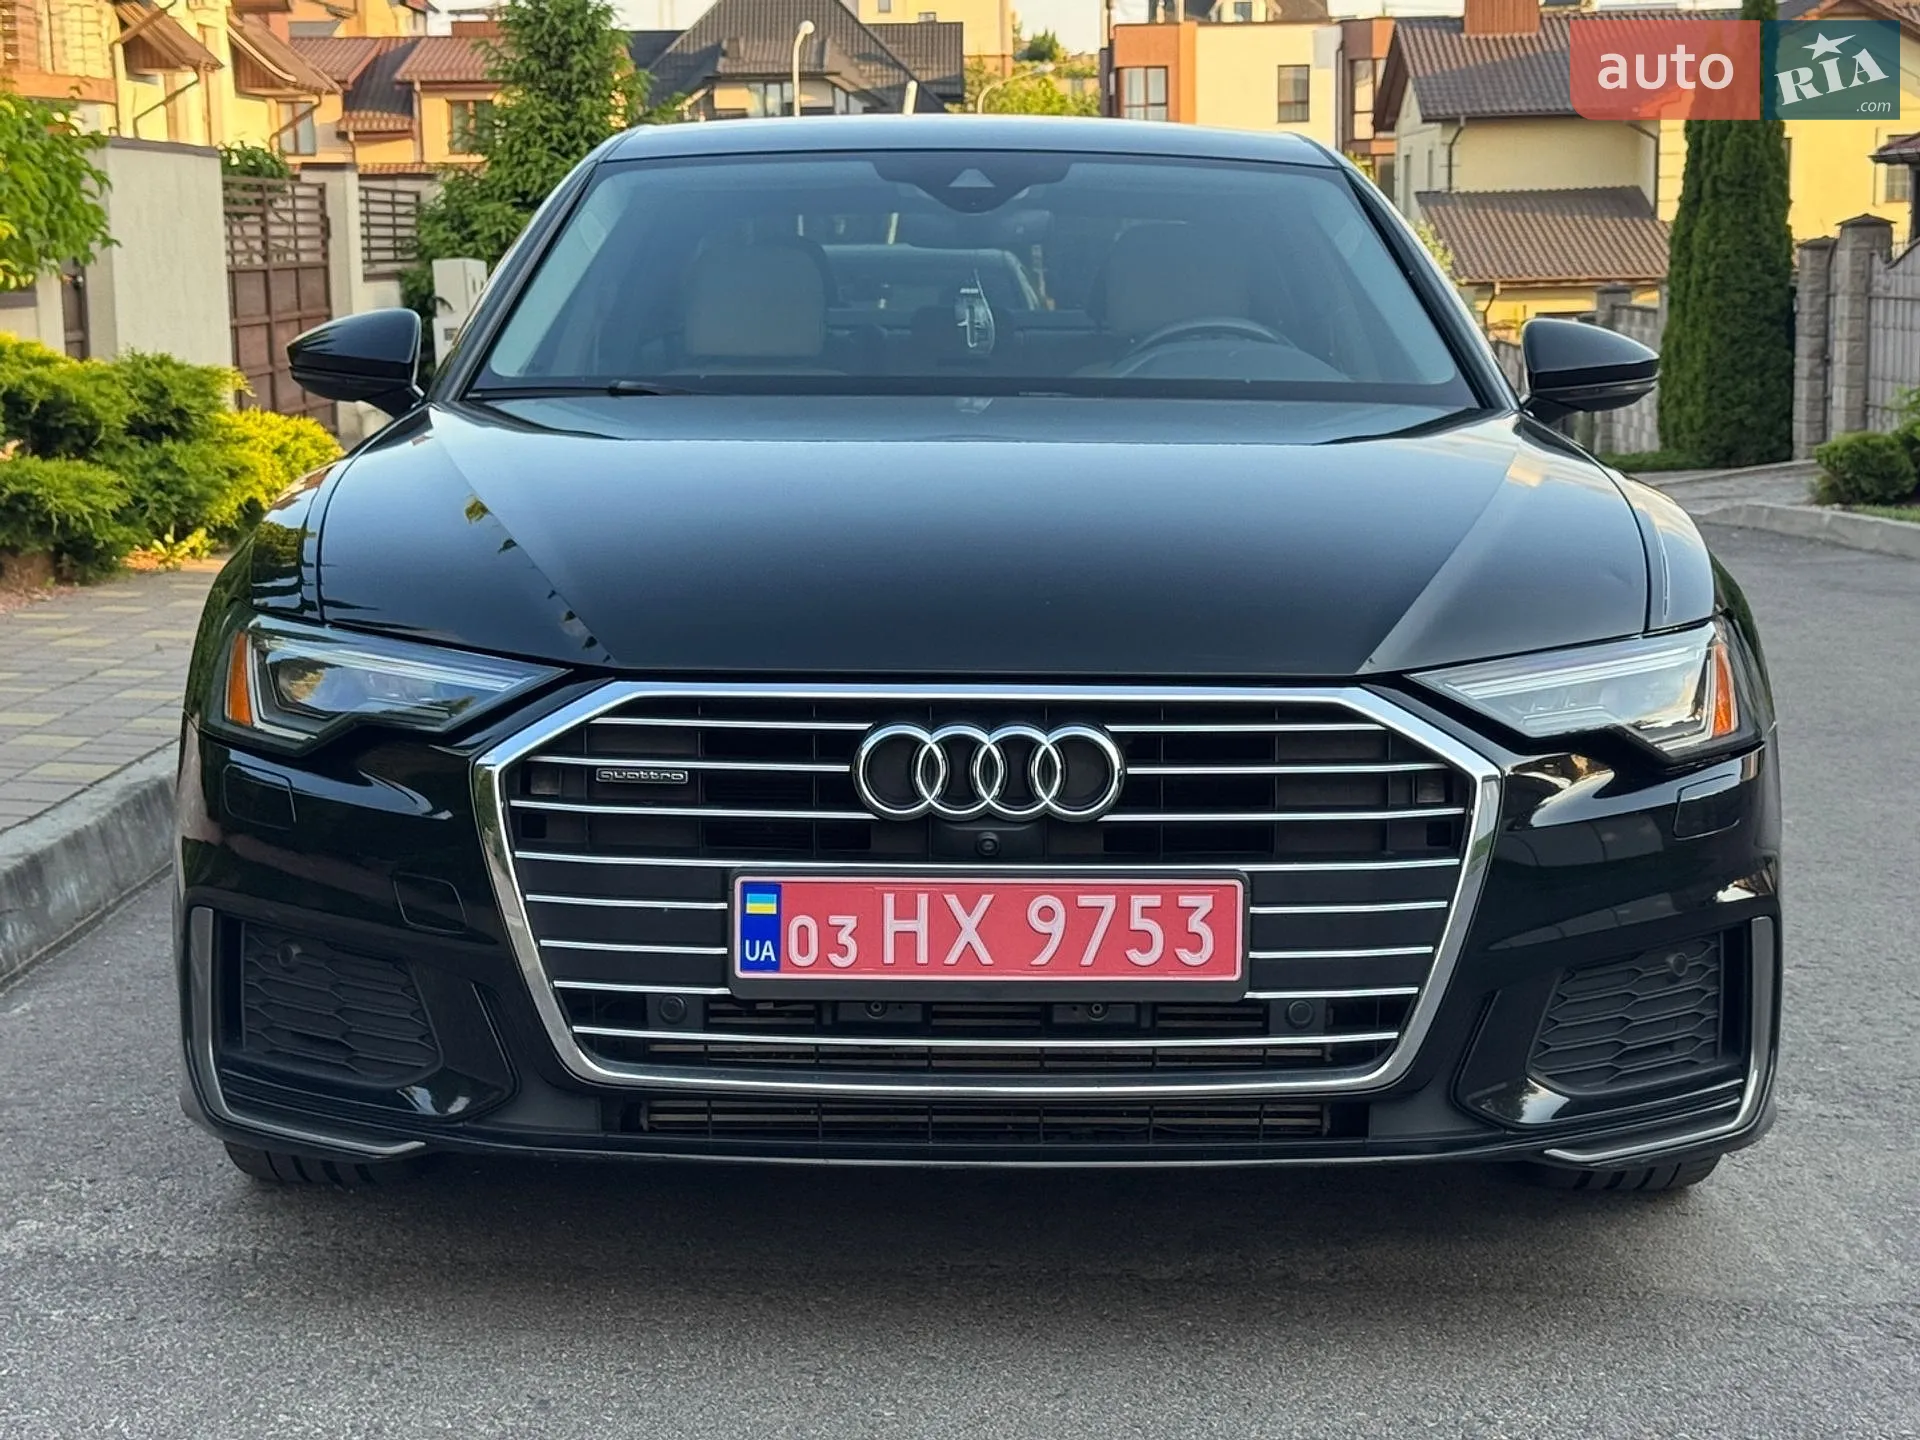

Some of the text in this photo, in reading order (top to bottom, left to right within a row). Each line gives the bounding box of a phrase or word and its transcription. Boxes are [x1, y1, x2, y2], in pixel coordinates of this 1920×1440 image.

[600, 770, 684, 781] quattro
[788, 893, 1216, 968] 03 HX 9753
[745, 939, 776, 962] UA
